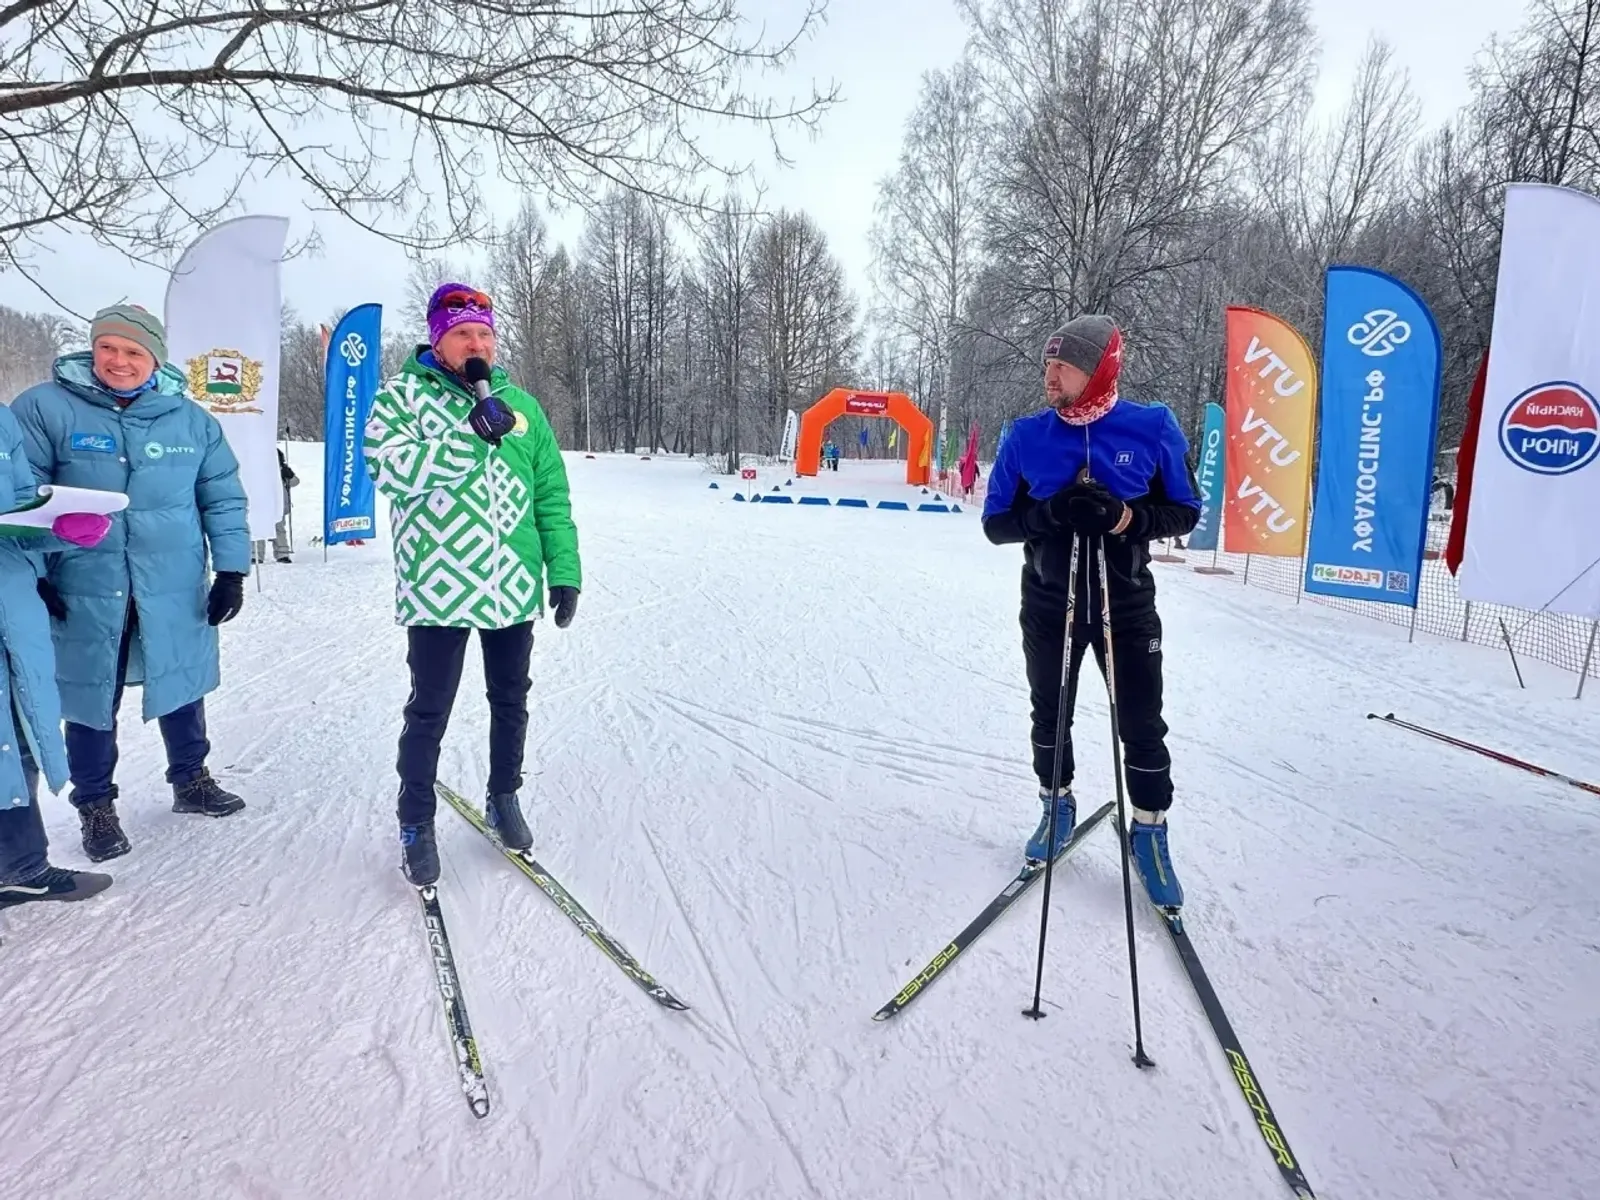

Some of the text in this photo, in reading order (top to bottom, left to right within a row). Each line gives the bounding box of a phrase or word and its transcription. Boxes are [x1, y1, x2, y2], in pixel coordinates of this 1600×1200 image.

[340, 375, 357, 507] УФАХОСПИС.РФ
[896, 943, 958, 1006] FISCHER
[1225, 1048, 1294, 1169] FISCHER
